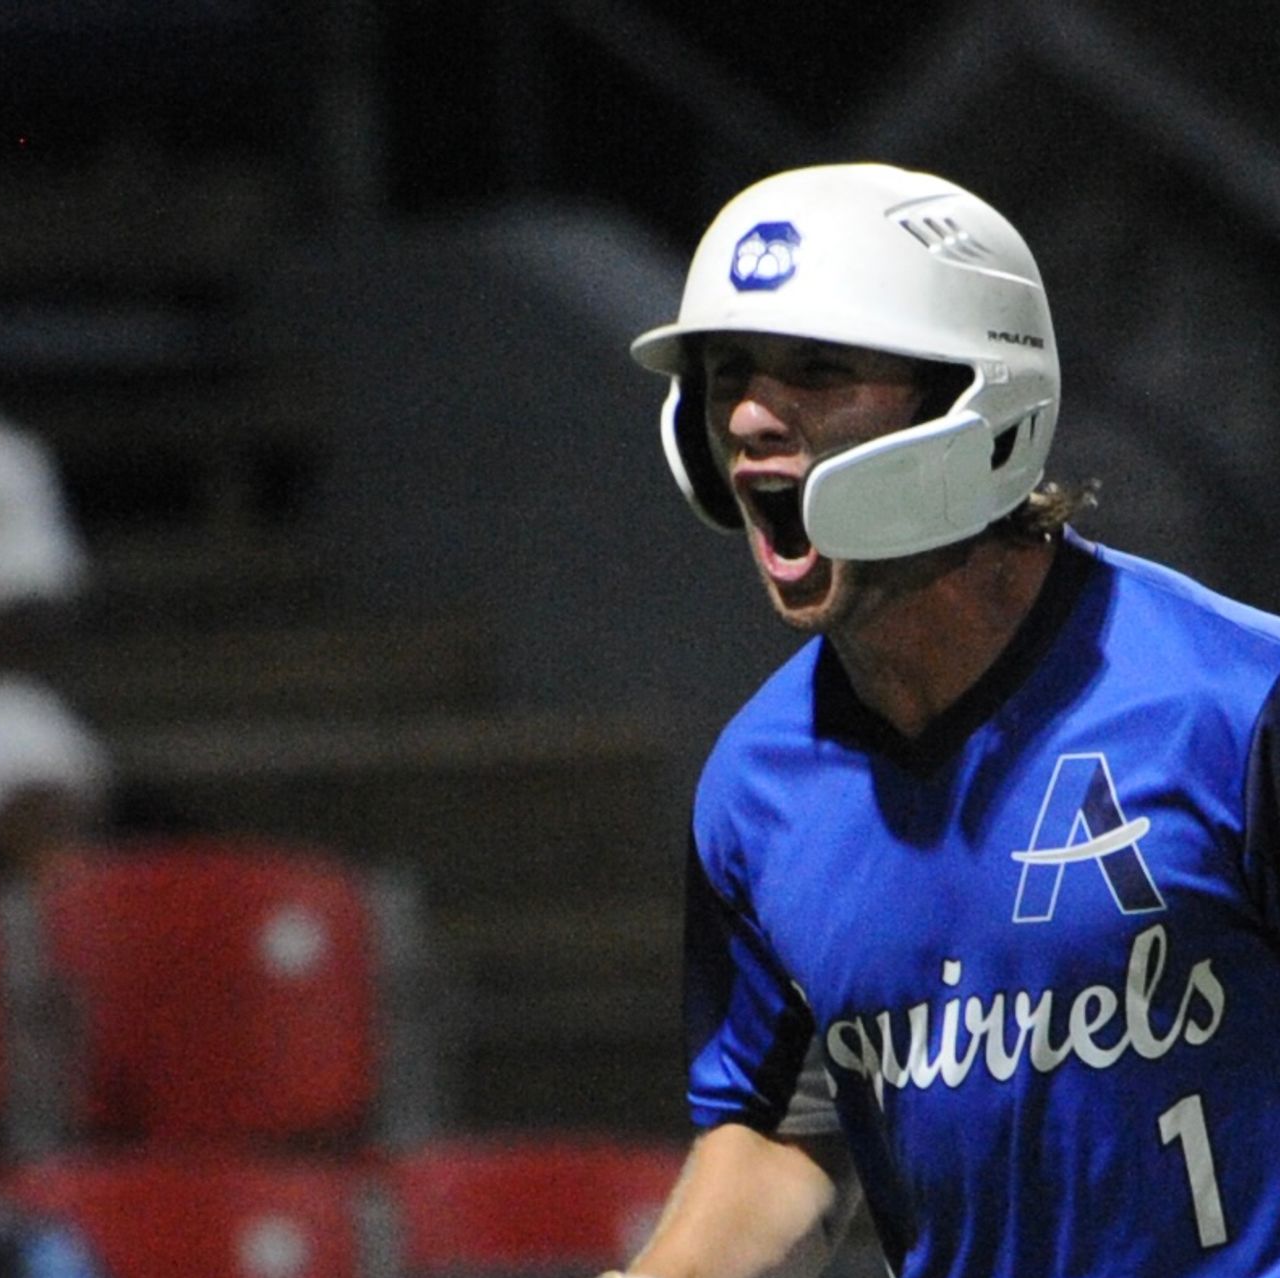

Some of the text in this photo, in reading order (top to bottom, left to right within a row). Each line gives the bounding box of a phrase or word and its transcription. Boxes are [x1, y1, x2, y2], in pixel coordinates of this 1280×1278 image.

[1012, 752, 1167, 923] A
[823, 923, 1225, 1113] quirrels
[1158, 1094, 1227, 1249] 1
